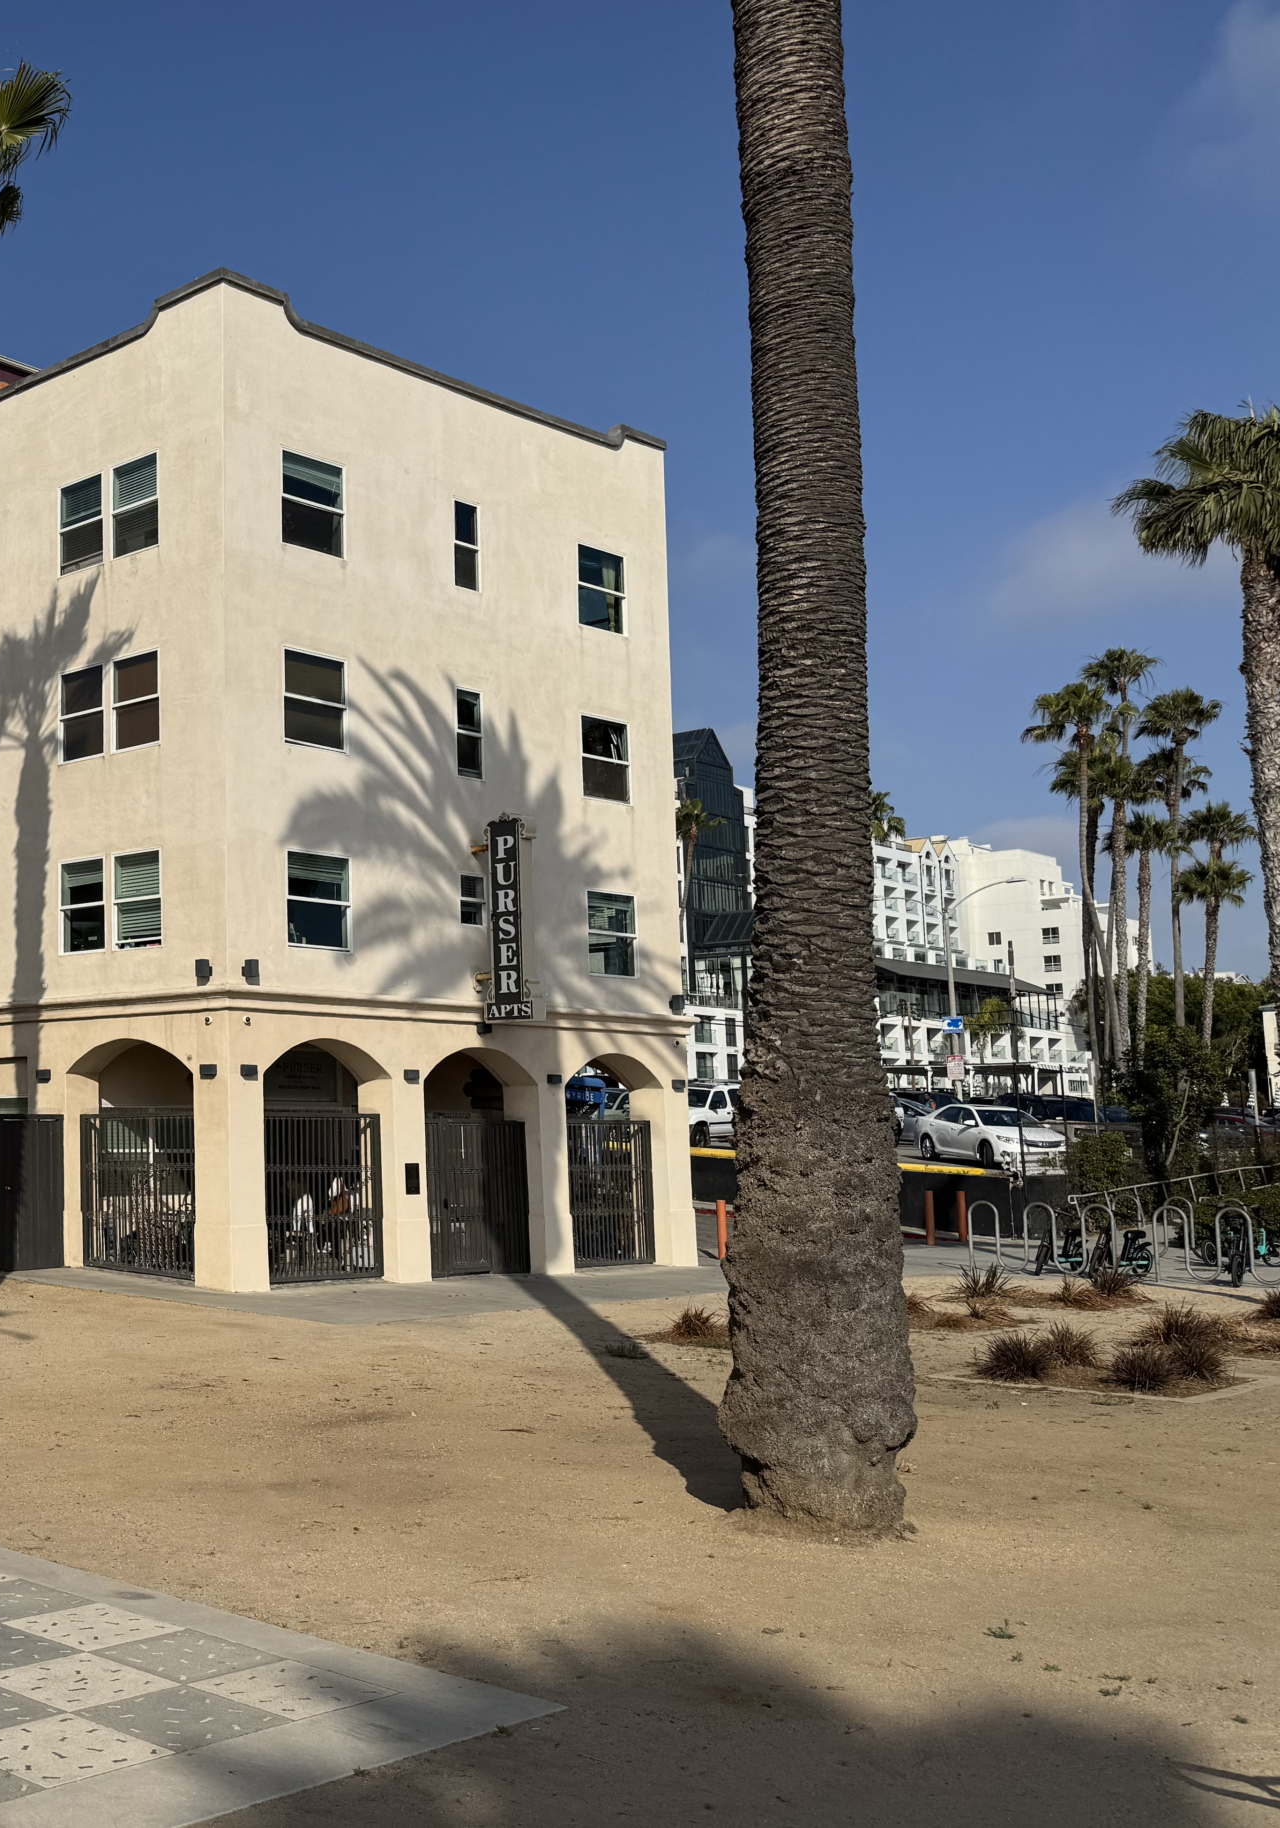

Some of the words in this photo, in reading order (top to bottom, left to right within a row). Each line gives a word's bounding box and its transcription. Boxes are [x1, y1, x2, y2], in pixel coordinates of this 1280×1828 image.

[495, 835, 519, 994] PURSER
[488, 1003, 531, 1019] APTS
[283, 1062, 323, 1074] PURSER
